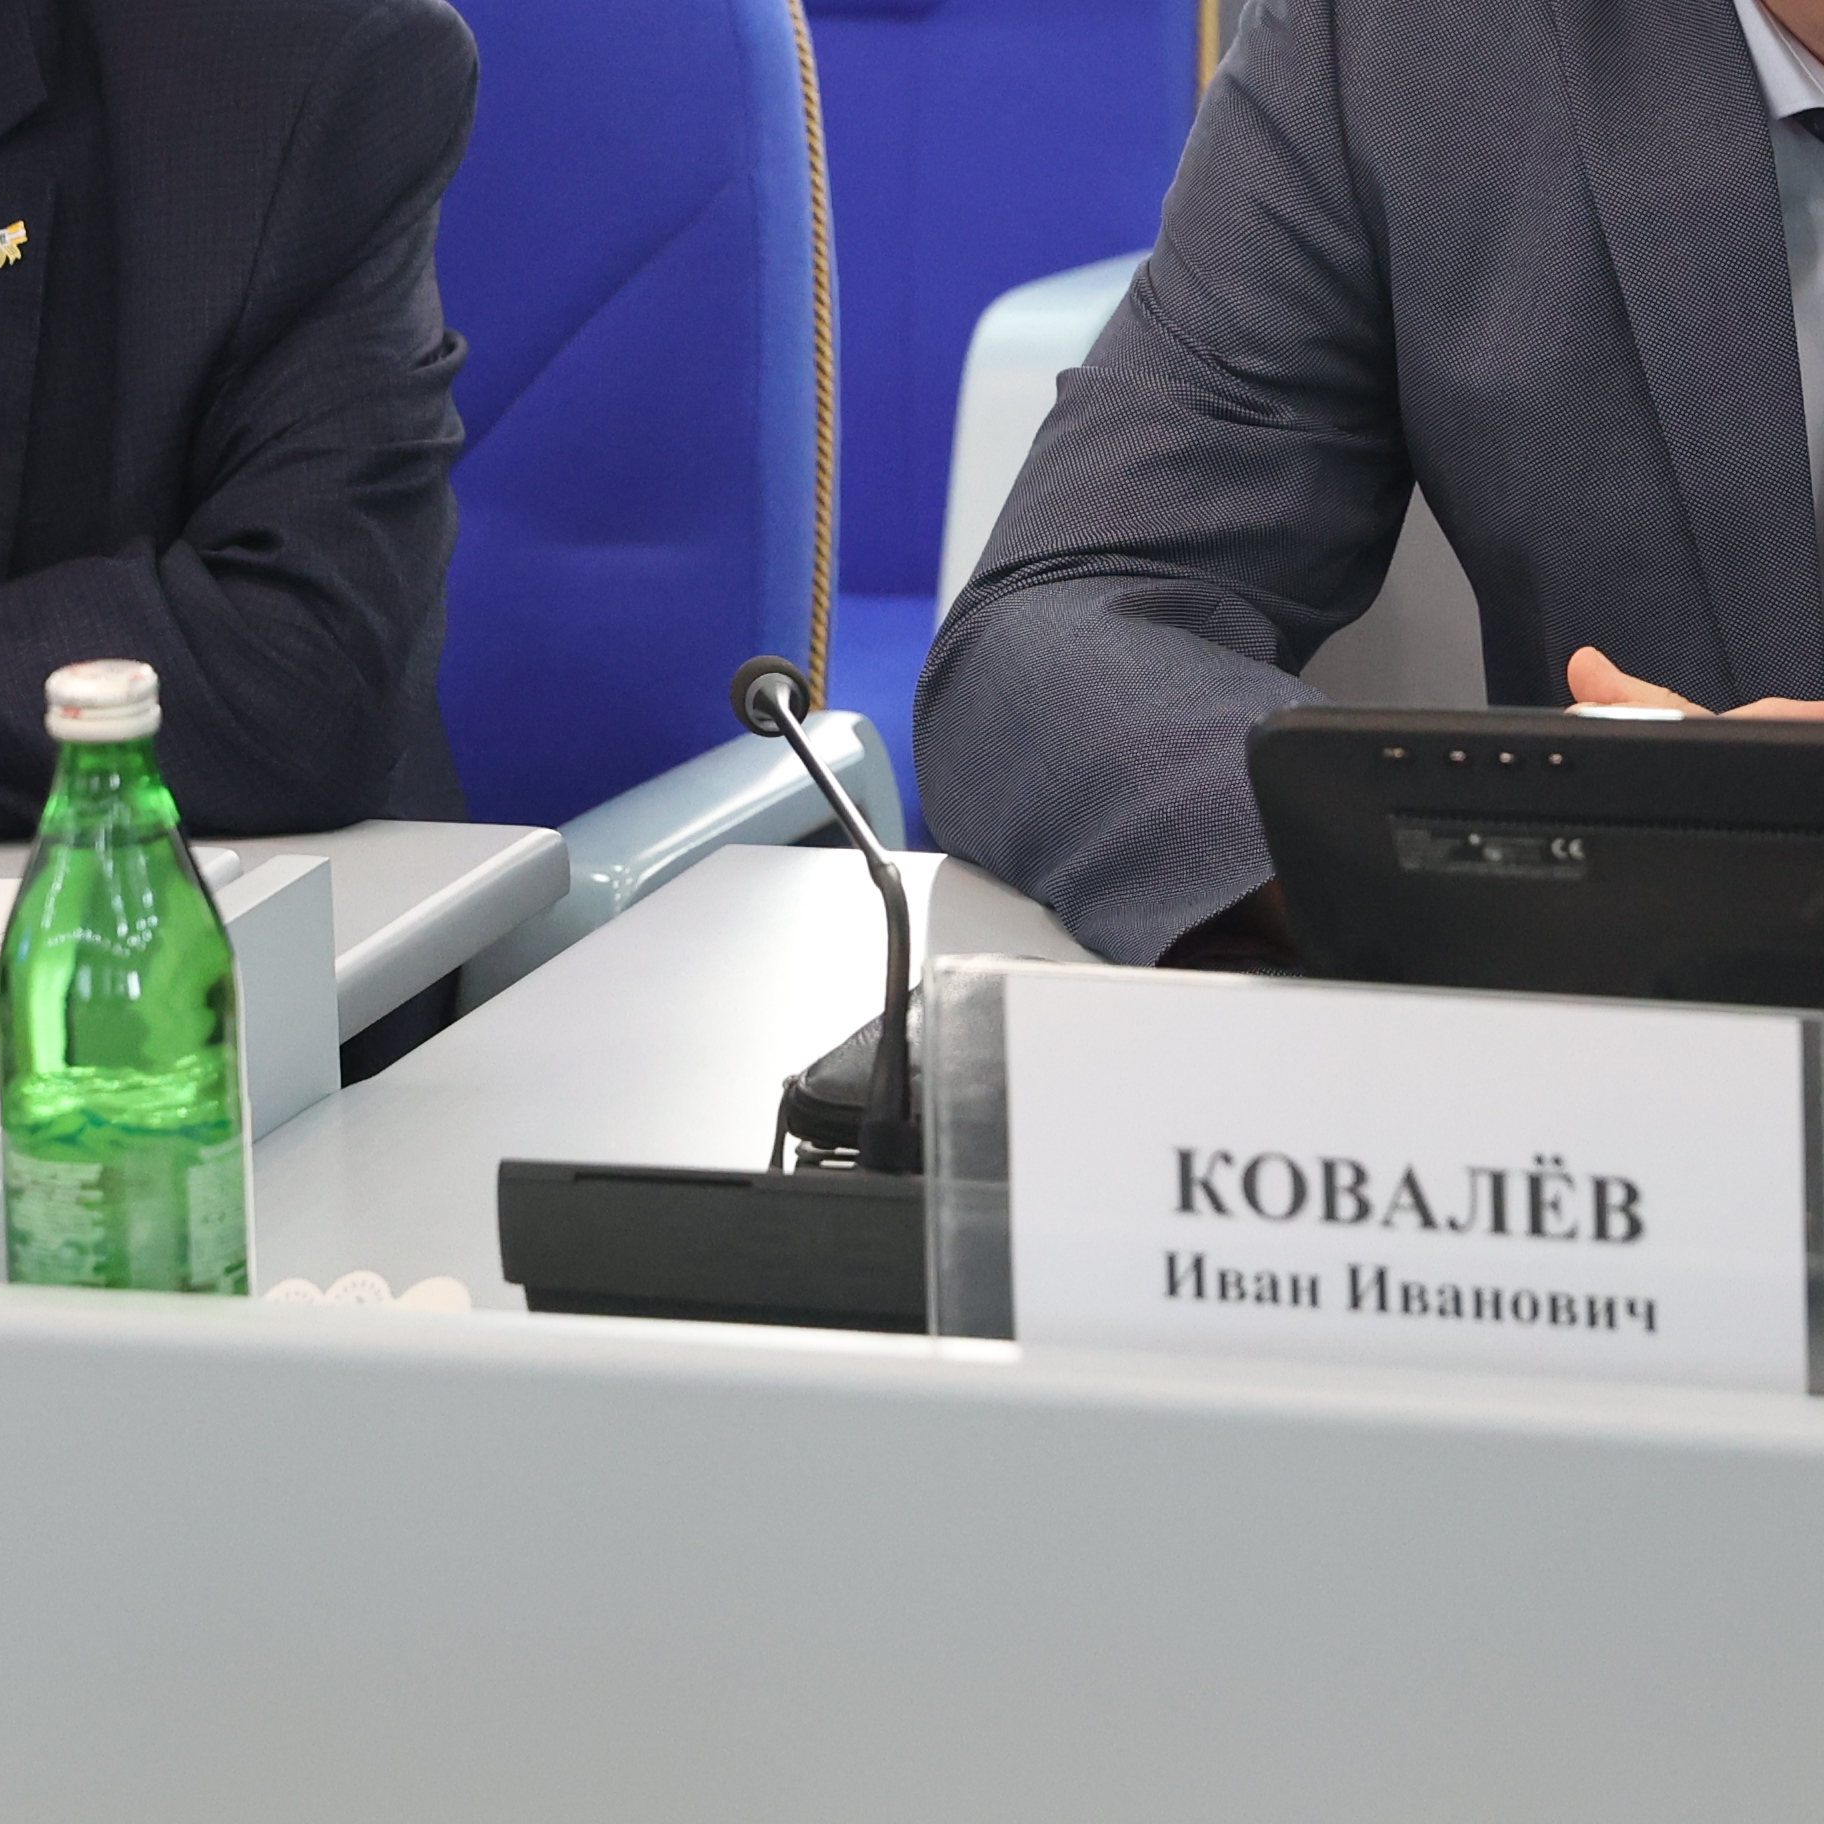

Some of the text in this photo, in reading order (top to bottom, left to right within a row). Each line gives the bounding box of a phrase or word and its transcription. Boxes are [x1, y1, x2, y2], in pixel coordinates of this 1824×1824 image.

[1175, 1147, 1646, 1245] КОВАЛЁВ
[1165, 1251, 1658, 1334] Иван Иванович
